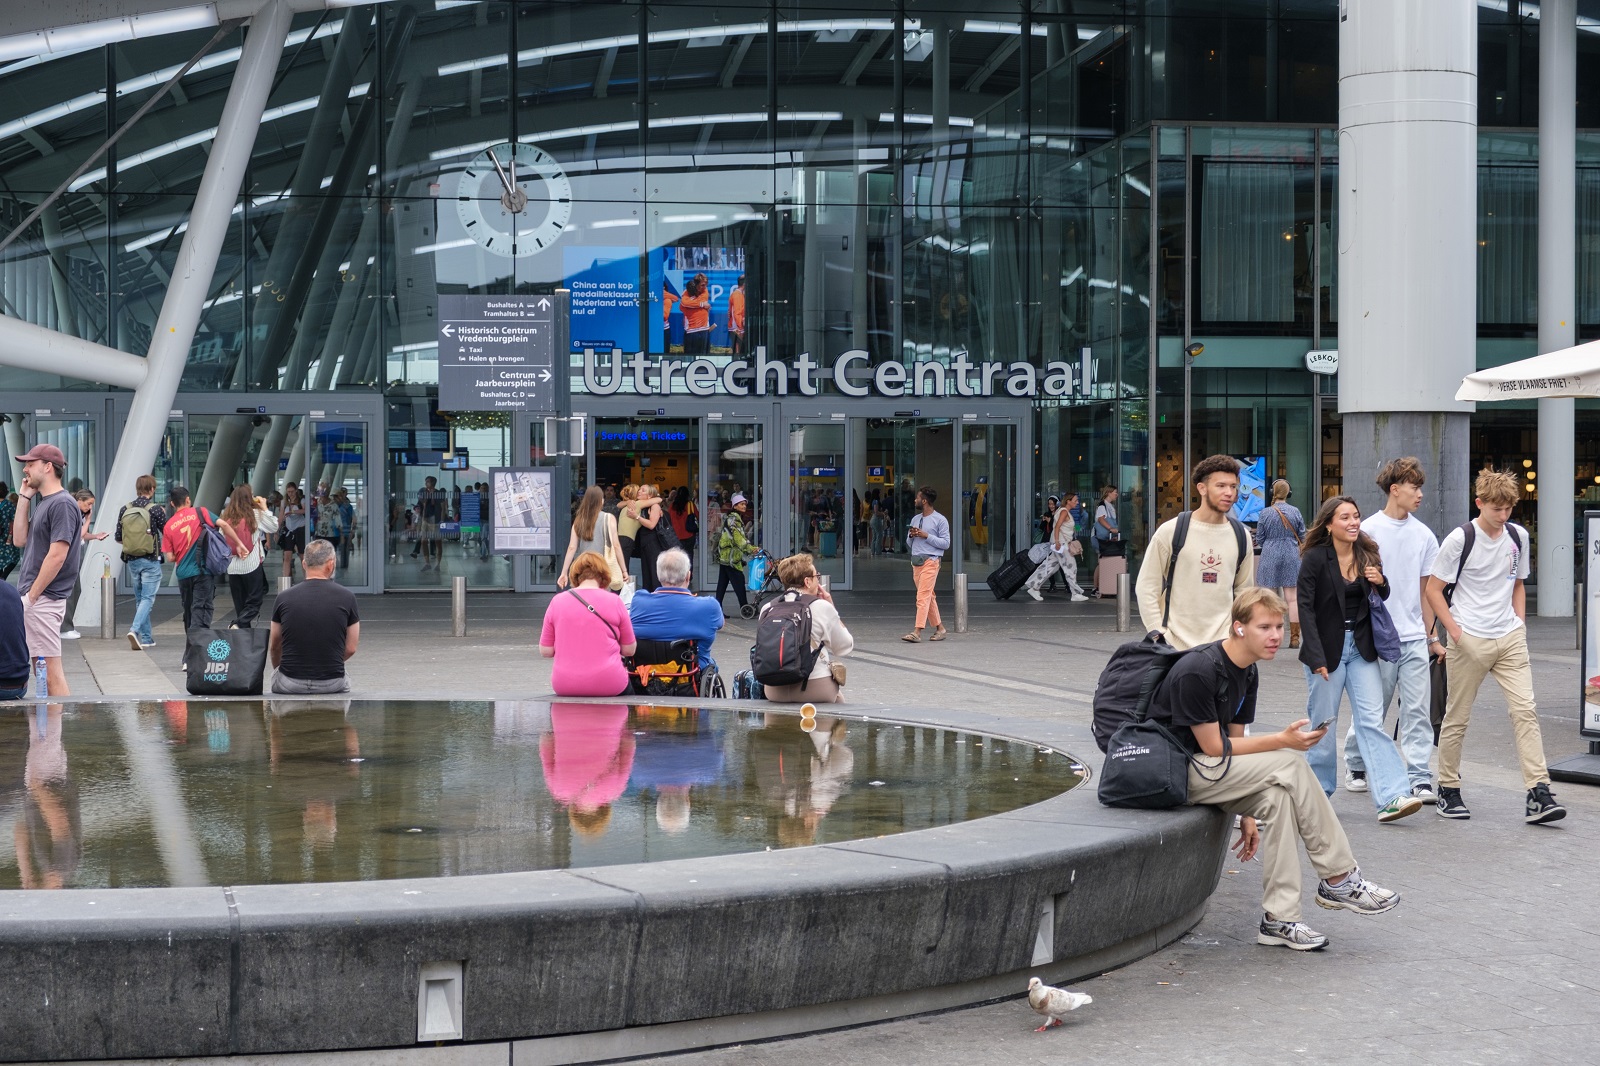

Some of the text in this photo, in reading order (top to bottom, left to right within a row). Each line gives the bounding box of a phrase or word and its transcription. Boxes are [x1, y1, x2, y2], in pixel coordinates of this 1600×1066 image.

[618, 282, 633, 290] kop
[458, 335, 528, 344] Vredenburgplein
[1310, 354, 1338, 363] LEBKOV
[583, 346, 818, 396] Utrecht
[833, 347, 1092, 396] Centraal
[475, 380, 536, 388] Jaarbeursplein
[1499, 378, 1567, 391] VERSE VLAAMSE FRIET
[601, 431, 638, 440] Service
[641, 431, 648, 440] &
[651, 431, 686, 440] Tickets
[170, 515, 196, 530] RONALDO
[180, 524, 192, 550] 7
[204, 662, 229, 673] JIP!
